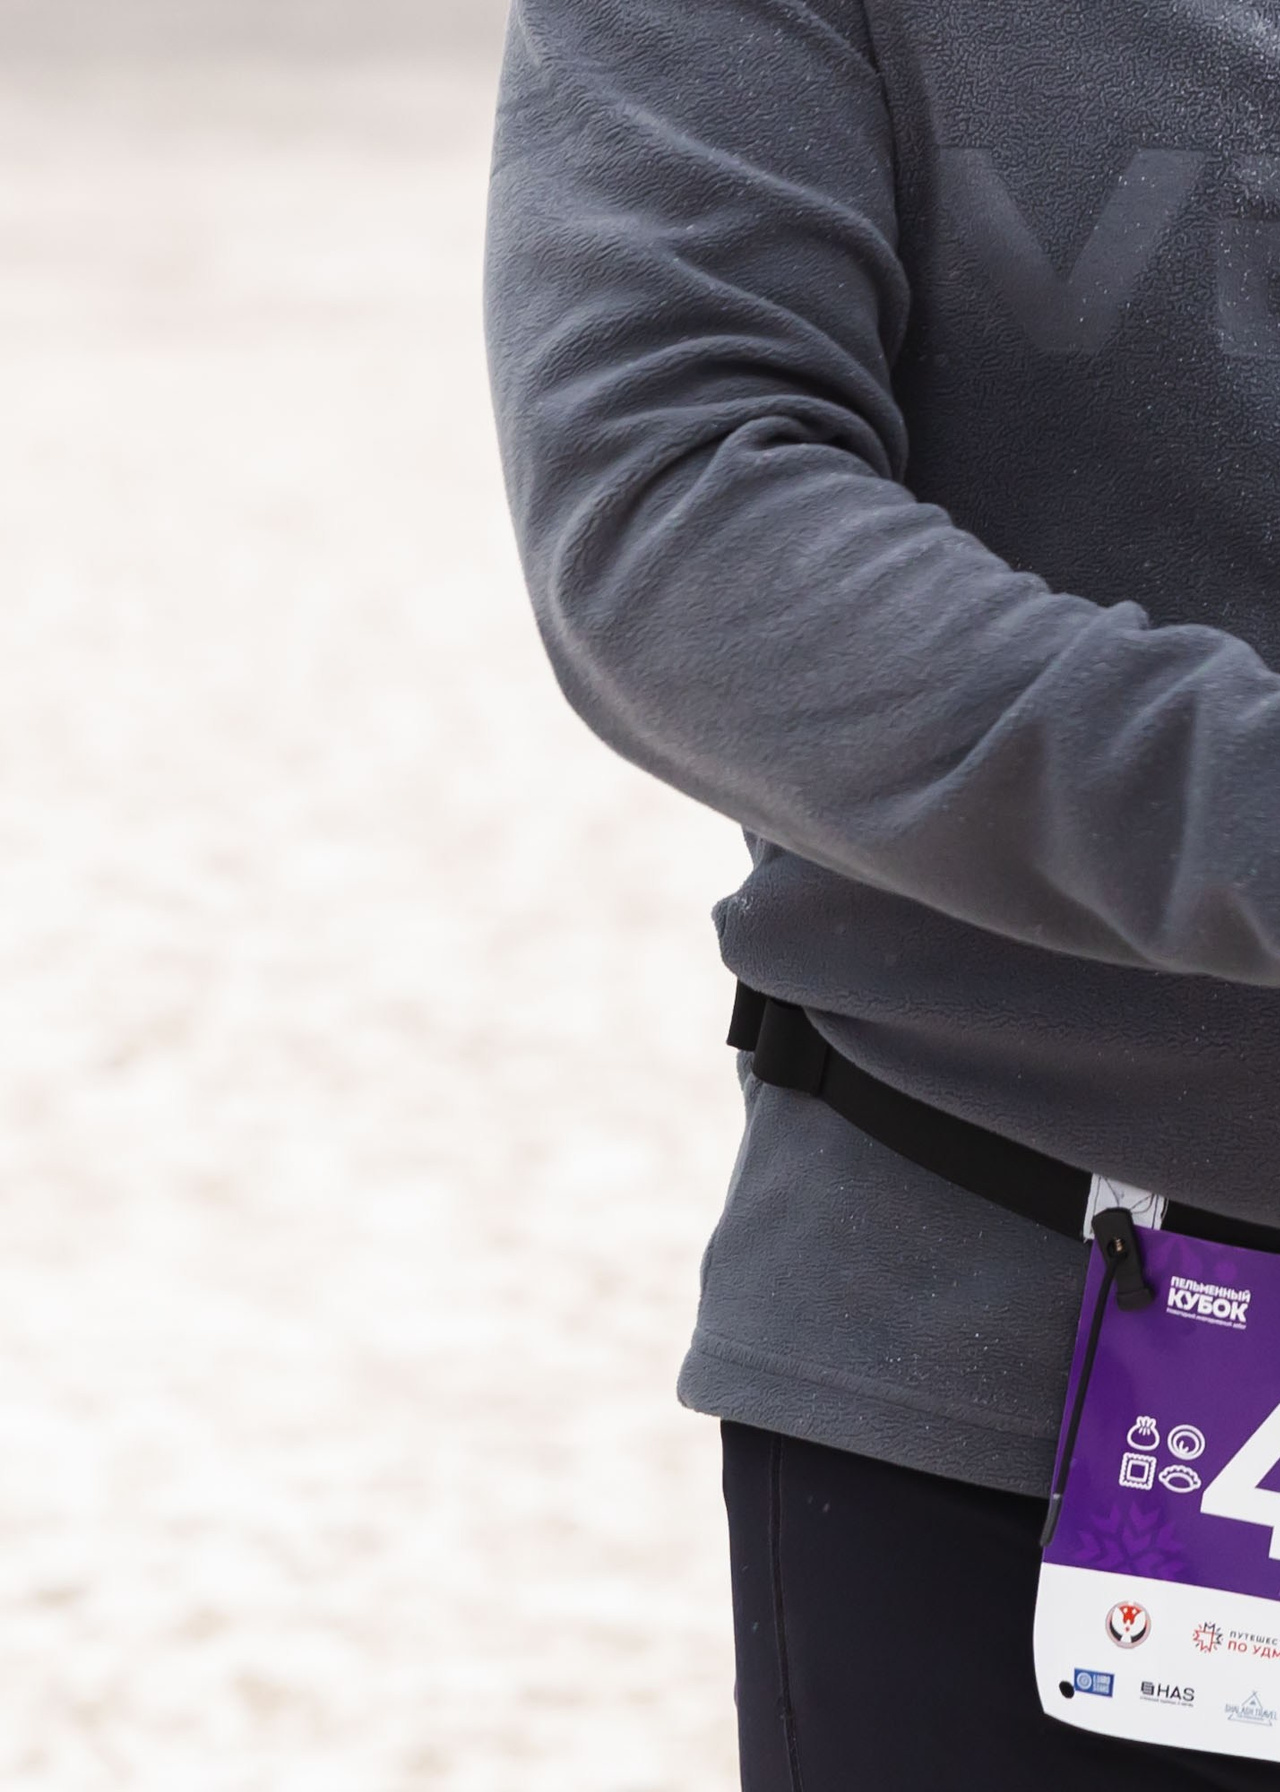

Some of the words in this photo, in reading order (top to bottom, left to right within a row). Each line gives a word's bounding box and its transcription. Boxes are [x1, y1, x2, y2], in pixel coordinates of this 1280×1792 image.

[1171, 1275, 1251, 1303] ПЕЛЬМЕННЫЙ
[1167, 1287, 1248, 1323] КУБОК
[1227, 1640, 1248, 1653] ПО
[1157, 1683, 1195, 1702] HAS
